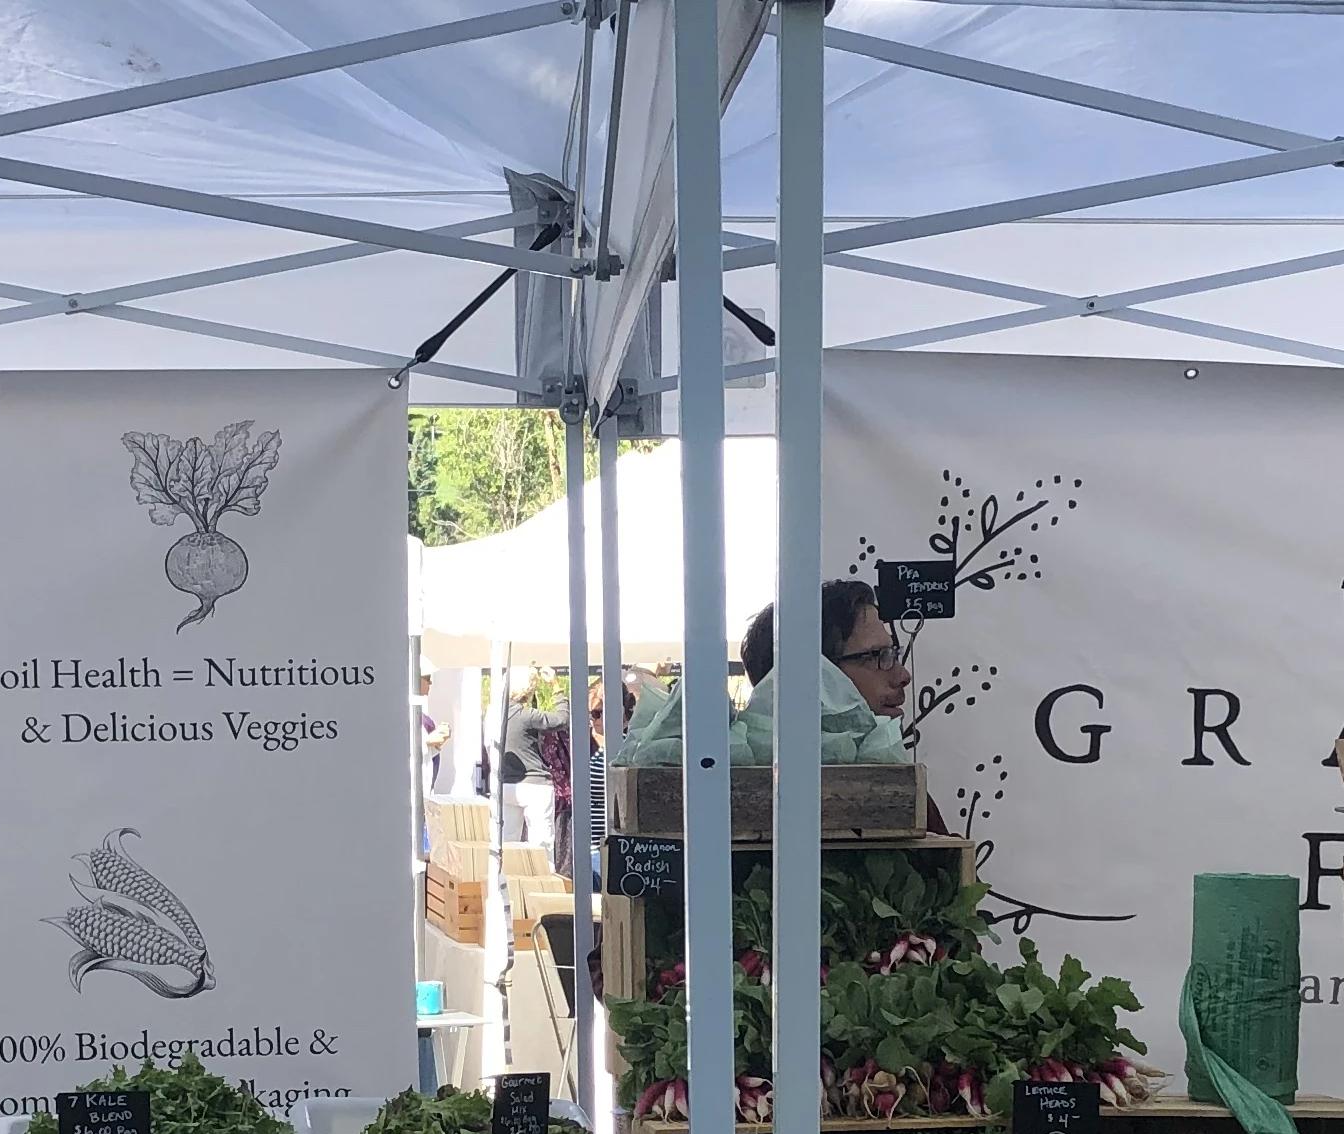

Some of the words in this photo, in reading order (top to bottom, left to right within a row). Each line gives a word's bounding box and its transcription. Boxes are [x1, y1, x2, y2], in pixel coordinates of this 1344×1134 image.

[50, 656, 162, 690] Health
[203, 656, 376, 688] Nutritious
[21, 716, 51, 744] &
[61, 711, 214, 743] Delicious
[221, 710, 339, 753] Veggies
[624, 855, 670, 874] Radish
[74, 1026, 300, 1069] Biodegradable
[309, 1028, 339, 1055] &
[67, 1095, 79, 1108] 7
[85, 1094, 128, 1108] KALE
[89, 1110, 133, 1124] BLEND
